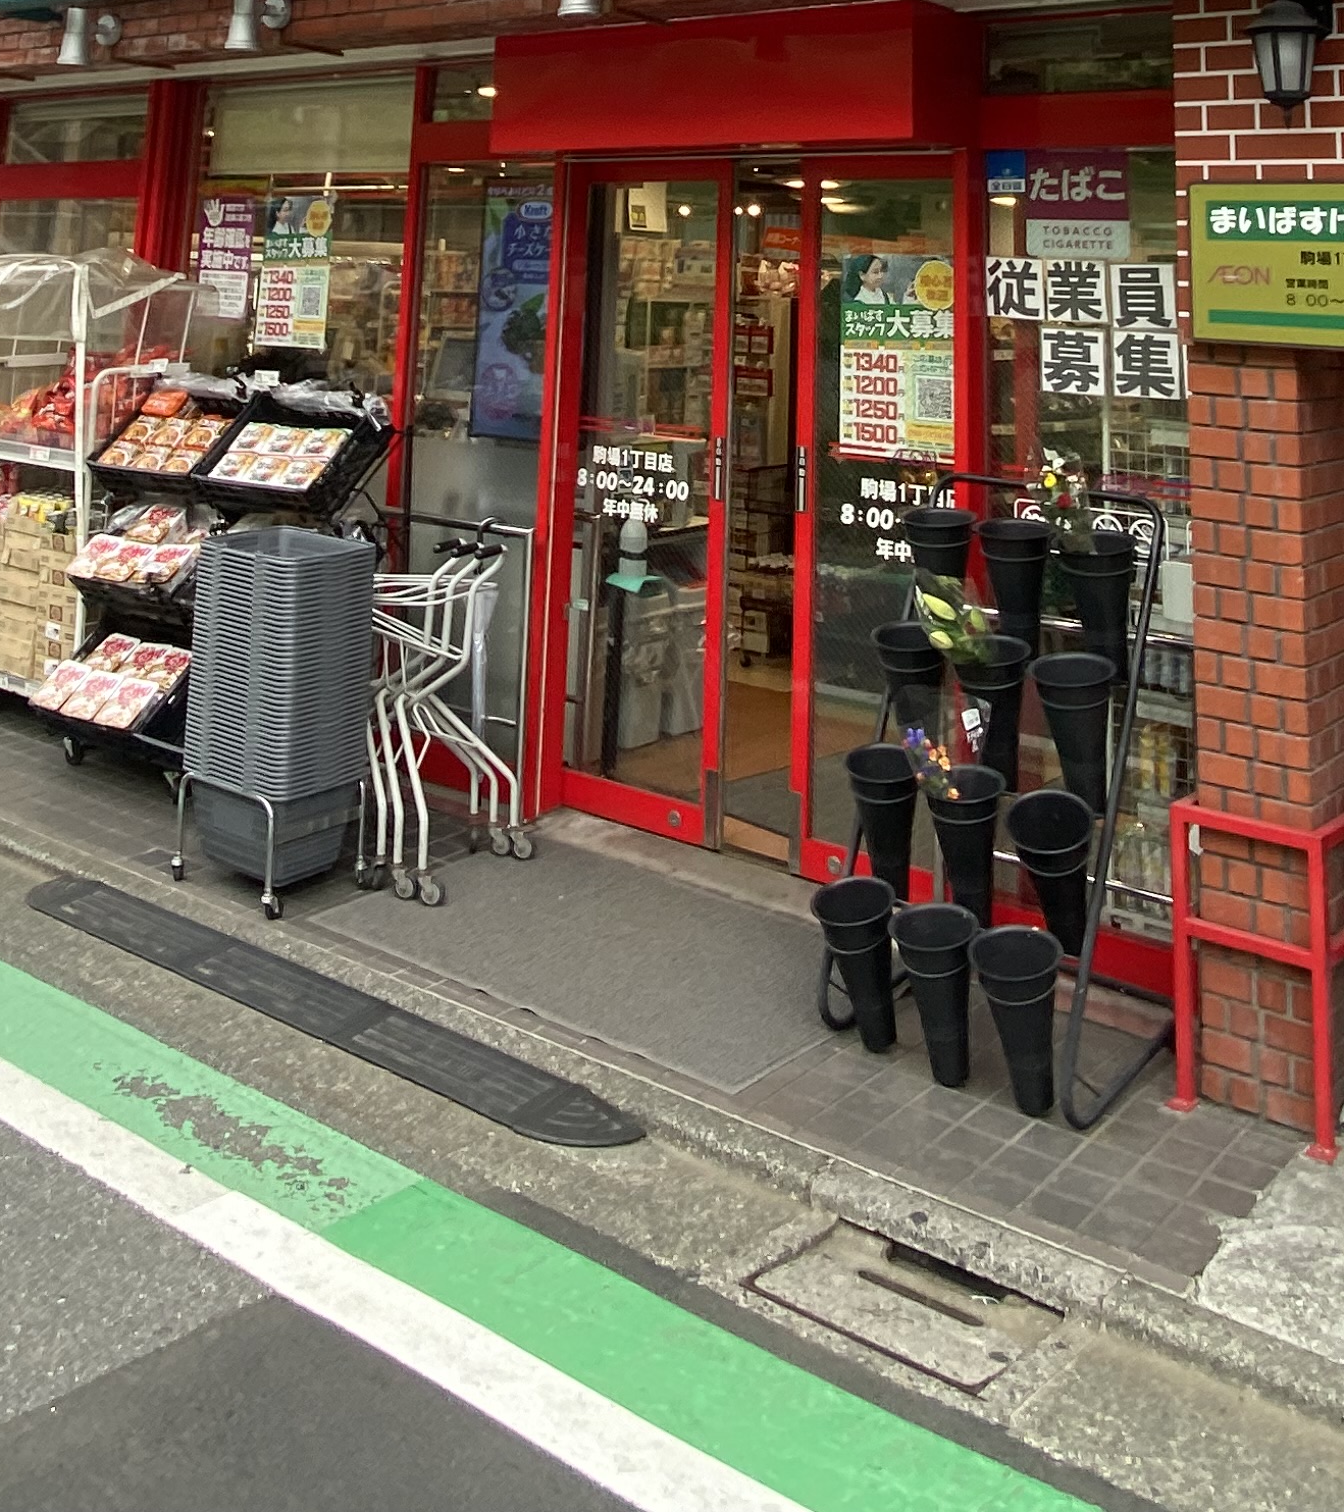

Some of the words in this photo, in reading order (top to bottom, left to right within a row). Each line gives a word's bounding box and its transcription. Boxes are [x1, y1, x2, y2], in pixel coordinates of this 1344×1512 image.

[1029, 165, 1126, 202] たばこ
[1042, 225, 1113, 237] TOBACCO
[1042, 238, 1114, 250] CIGARETTE
[987, 258, 1174, 329] 従業員
[886, 309, 954, 338] 大募集
[1042, 331, 1176, 396] 募集
[592, 445, 675, 473] 駒場1丁目店
[602, 498, 659, 523] 年中無休
